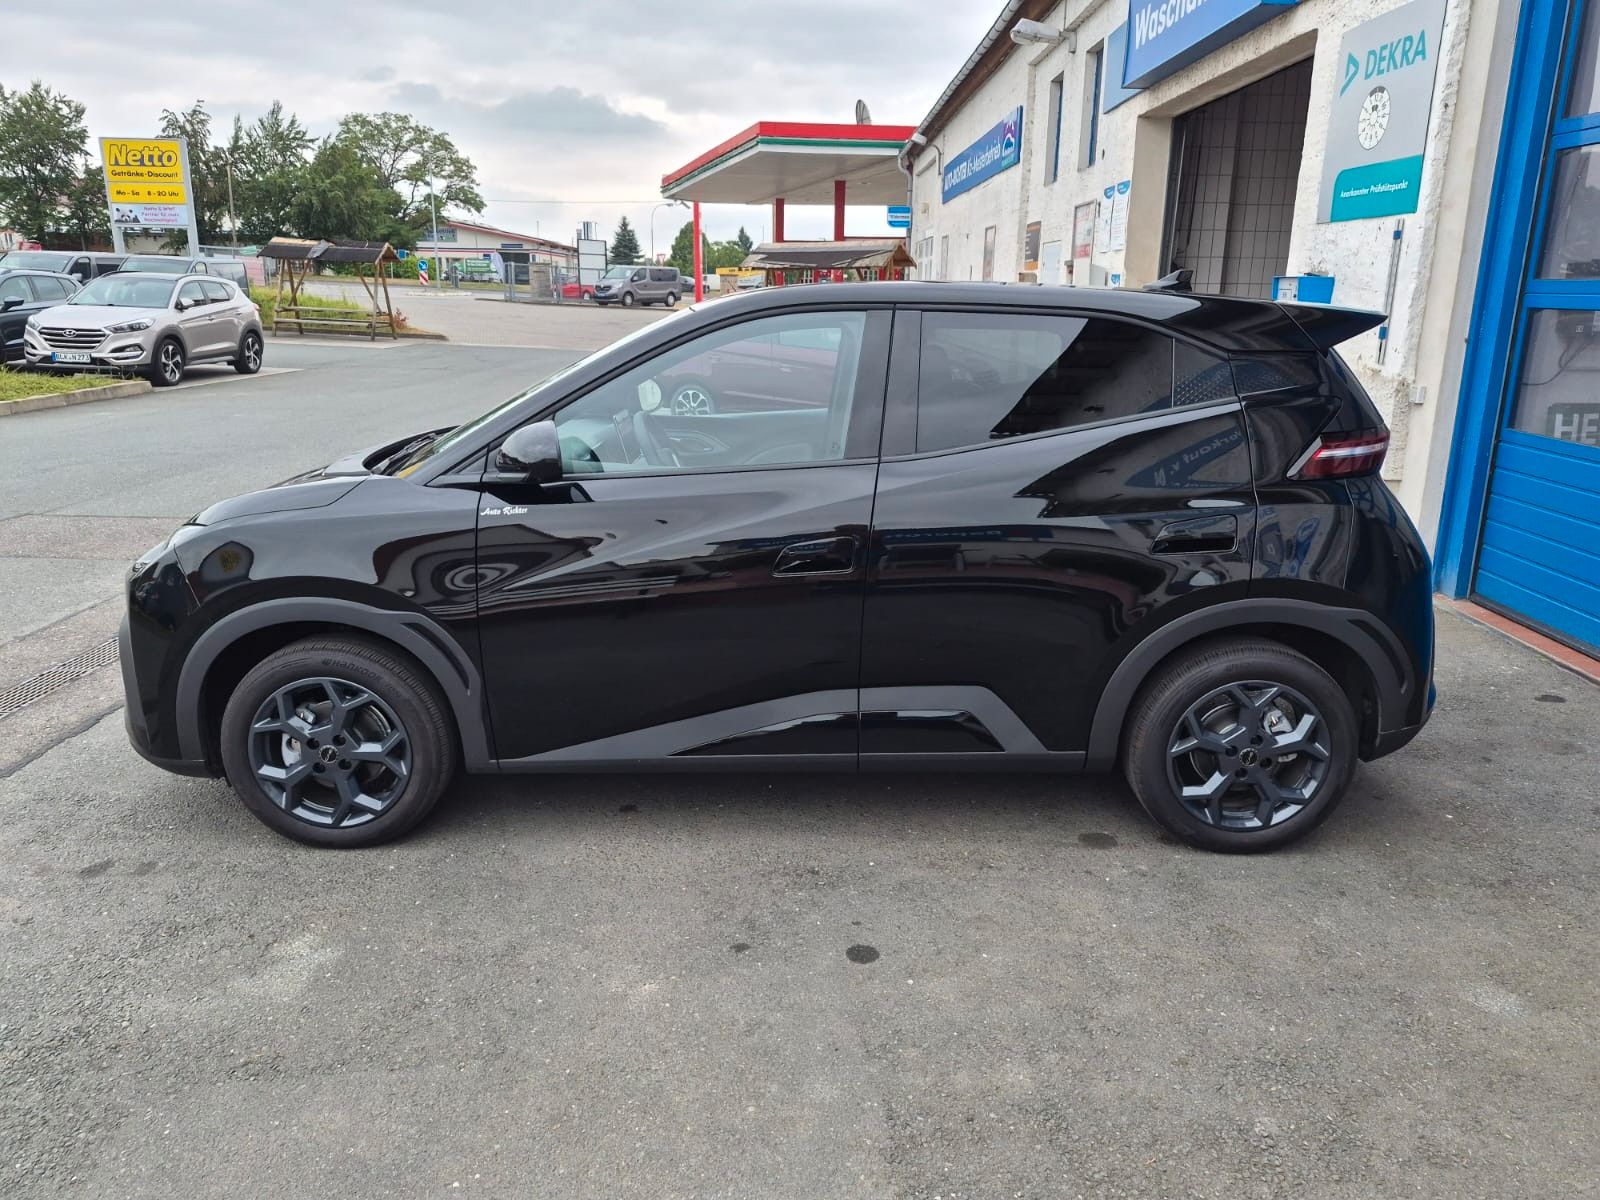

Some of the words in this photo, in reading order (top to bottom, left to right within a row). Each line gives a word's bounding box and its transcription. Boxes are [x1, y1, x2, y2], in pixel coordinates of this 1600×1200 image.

[1135, 0, 1206, 49] Wascha
[1364, 29, 1427, 80] DEKRA
[109, 144, 177, 167] Netto
[480, 507, 501, 515] Auto
[502, 506, 528, 515] Richter
